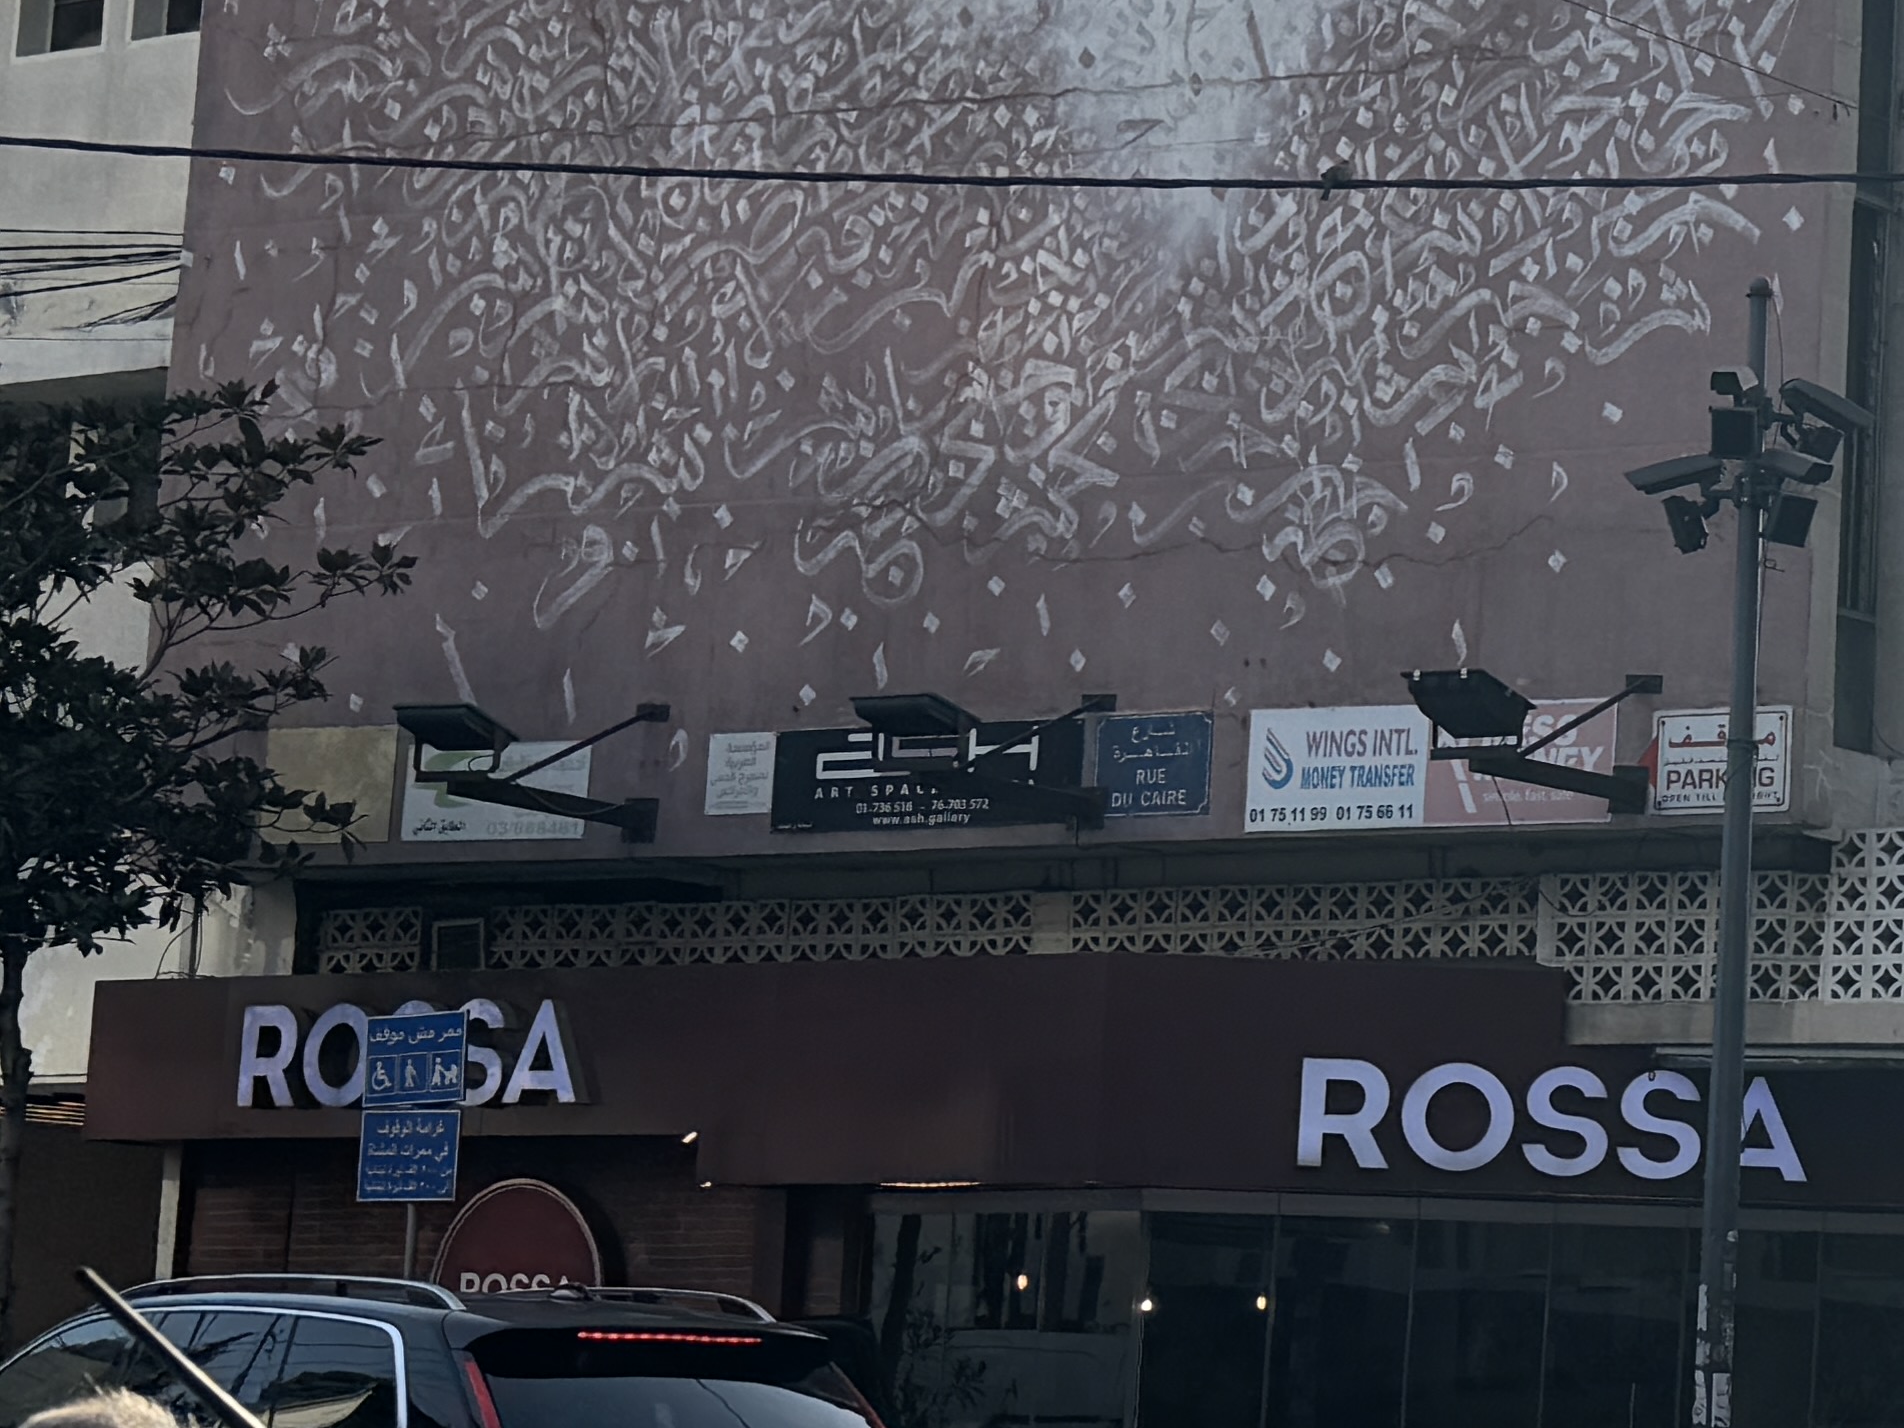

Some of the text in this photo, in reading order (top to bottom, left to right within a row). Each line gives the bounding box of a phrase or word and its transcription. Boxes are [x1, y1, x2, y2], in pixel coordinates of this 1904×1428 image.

[1304, 726, 1419, 759] WINGS INTL.
[1668, 724, 1777, 750] مقف
[1136, 768, 1167, 785] RUE
[1299, 763, 1416, 790] MONEY TRANSFER
[1666, 766, 1775, 791] PARKG
[814, 786, 855, 800] ART
[1111, 789, 1187, 808] DU CAIRE
[1249, 808, 1266, 823] 01
[1269, 807, 1288, 823] 75
[1290, 806, 1307, 822] 11
[1309, 805, 1328, 821] 99
[1335, 806, 1353, 821] 01
[1356, 805, 1374, 820] 75
[1398, 804, 1414, 820] 11
[238, 999, 576, 1109] ROSA
[1296, 1056, 1808, 1183] ROSSA
